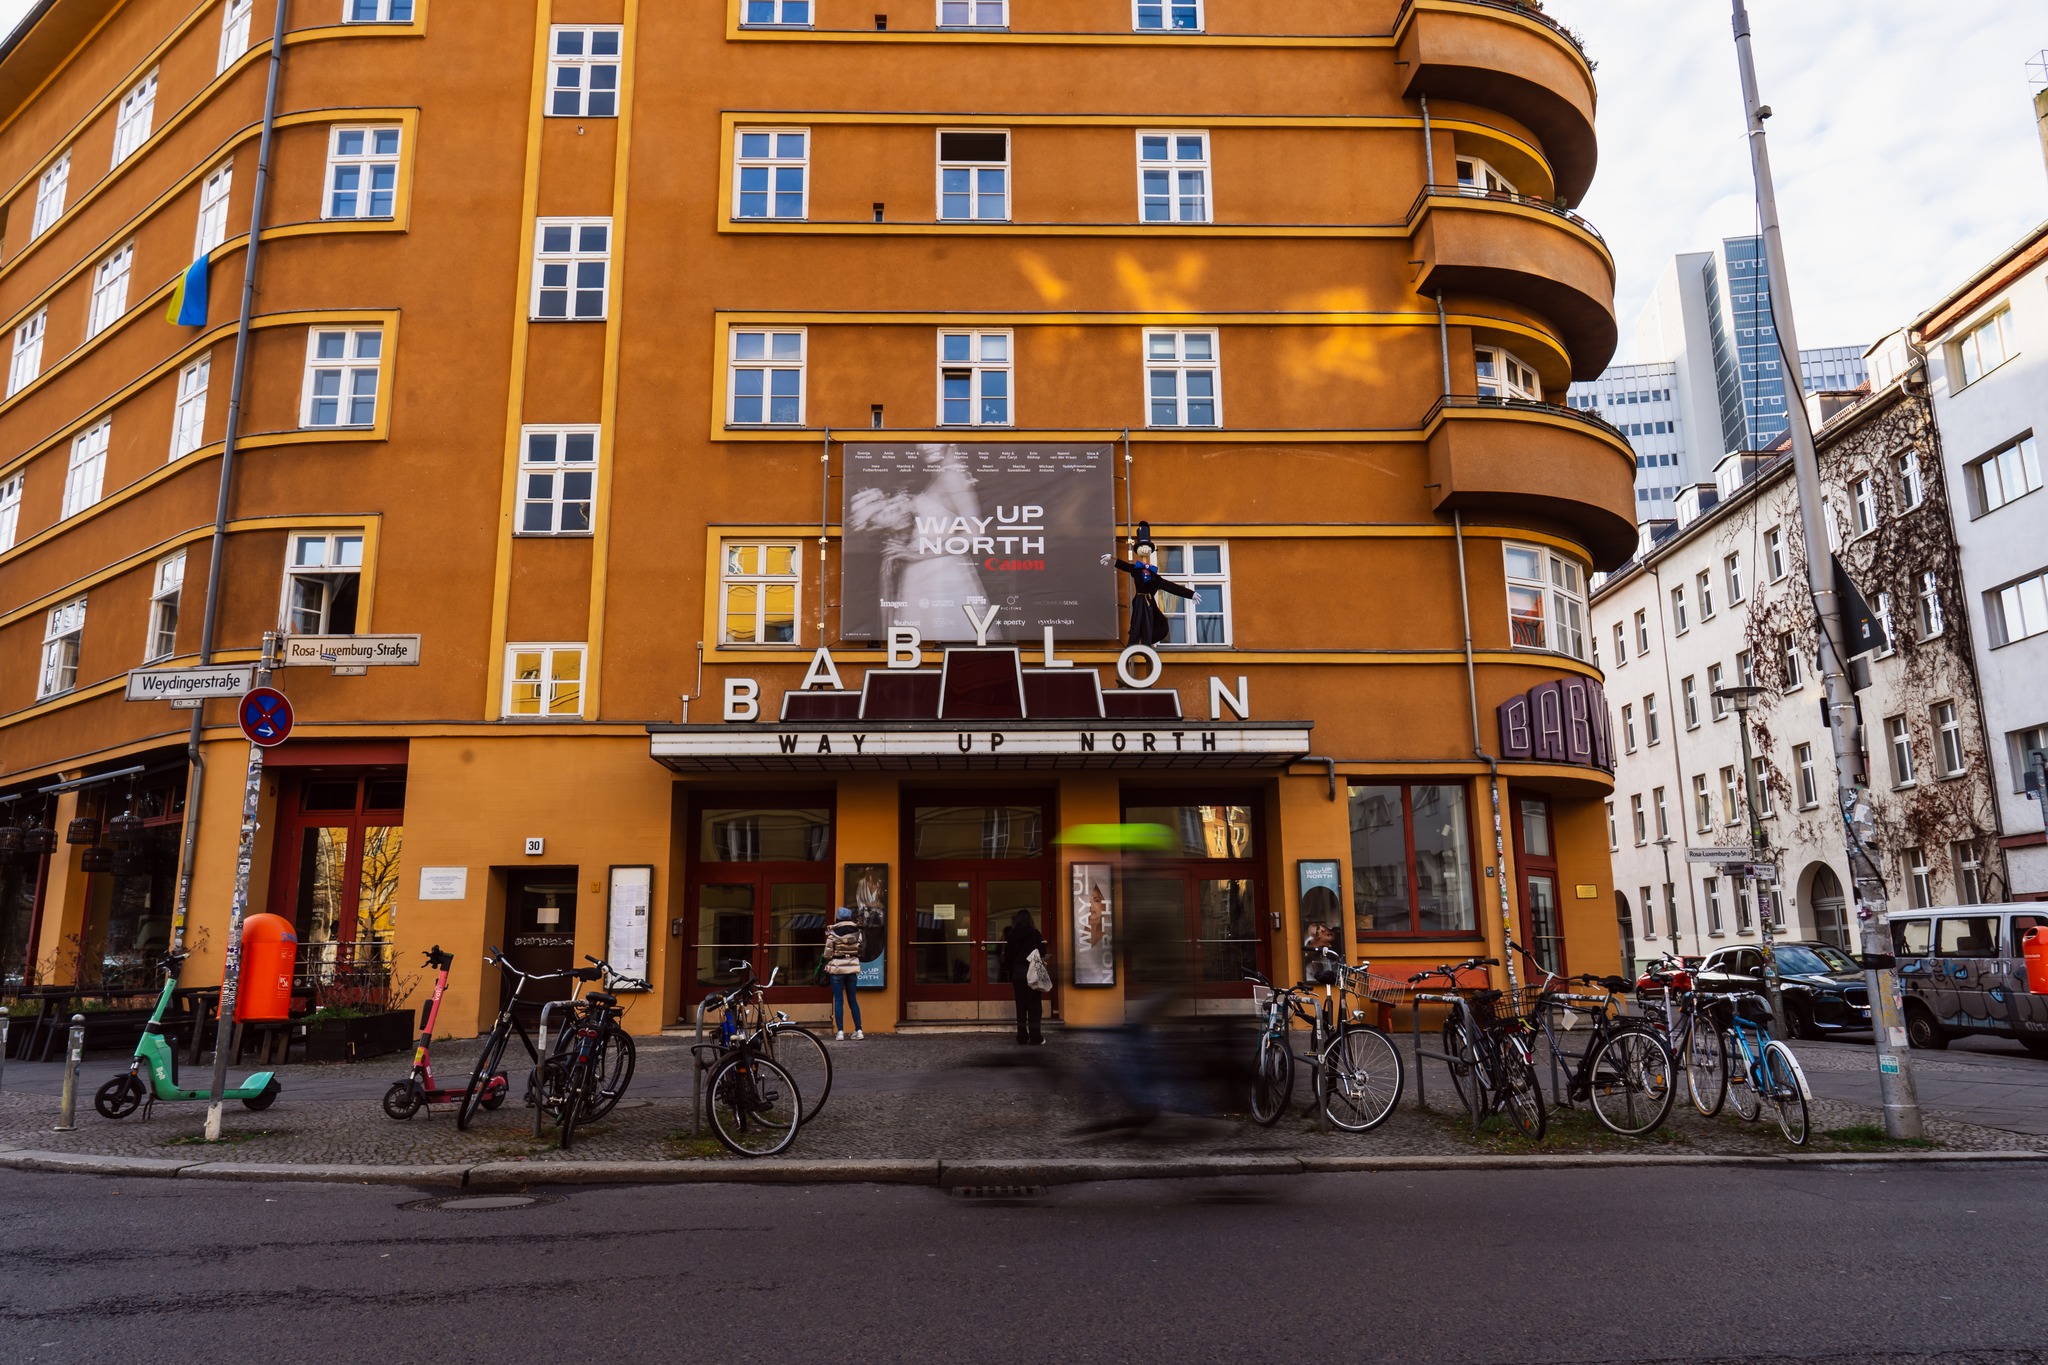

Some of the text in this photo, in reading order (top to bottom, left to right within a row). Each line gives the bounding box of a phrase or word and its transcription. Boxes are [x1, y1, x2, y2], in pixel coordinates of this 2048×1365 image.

[915, 505, 1044, 534] WAY UP
[920, 536, 1044, 555] NORTH
[984, 557, 1045, 571] Canon
[880, 598, 908, 609] imagen
[292, 643, 407, 658] Rosa-Luxemburg-Straße
[723, 604, 1249, 722] BABYLON
[142, 673, 240, 693] Weydingerstraße
[779, 732, 1217, 755] WAY UP NORTH
[528, 840, 540, 851] 30
[1689, 850, 1747, 858] Rosa-Luxemburg-Straße
[1079, 897, 1092, 952] WAY
[1102, 899, 1113, 983] NORTH
